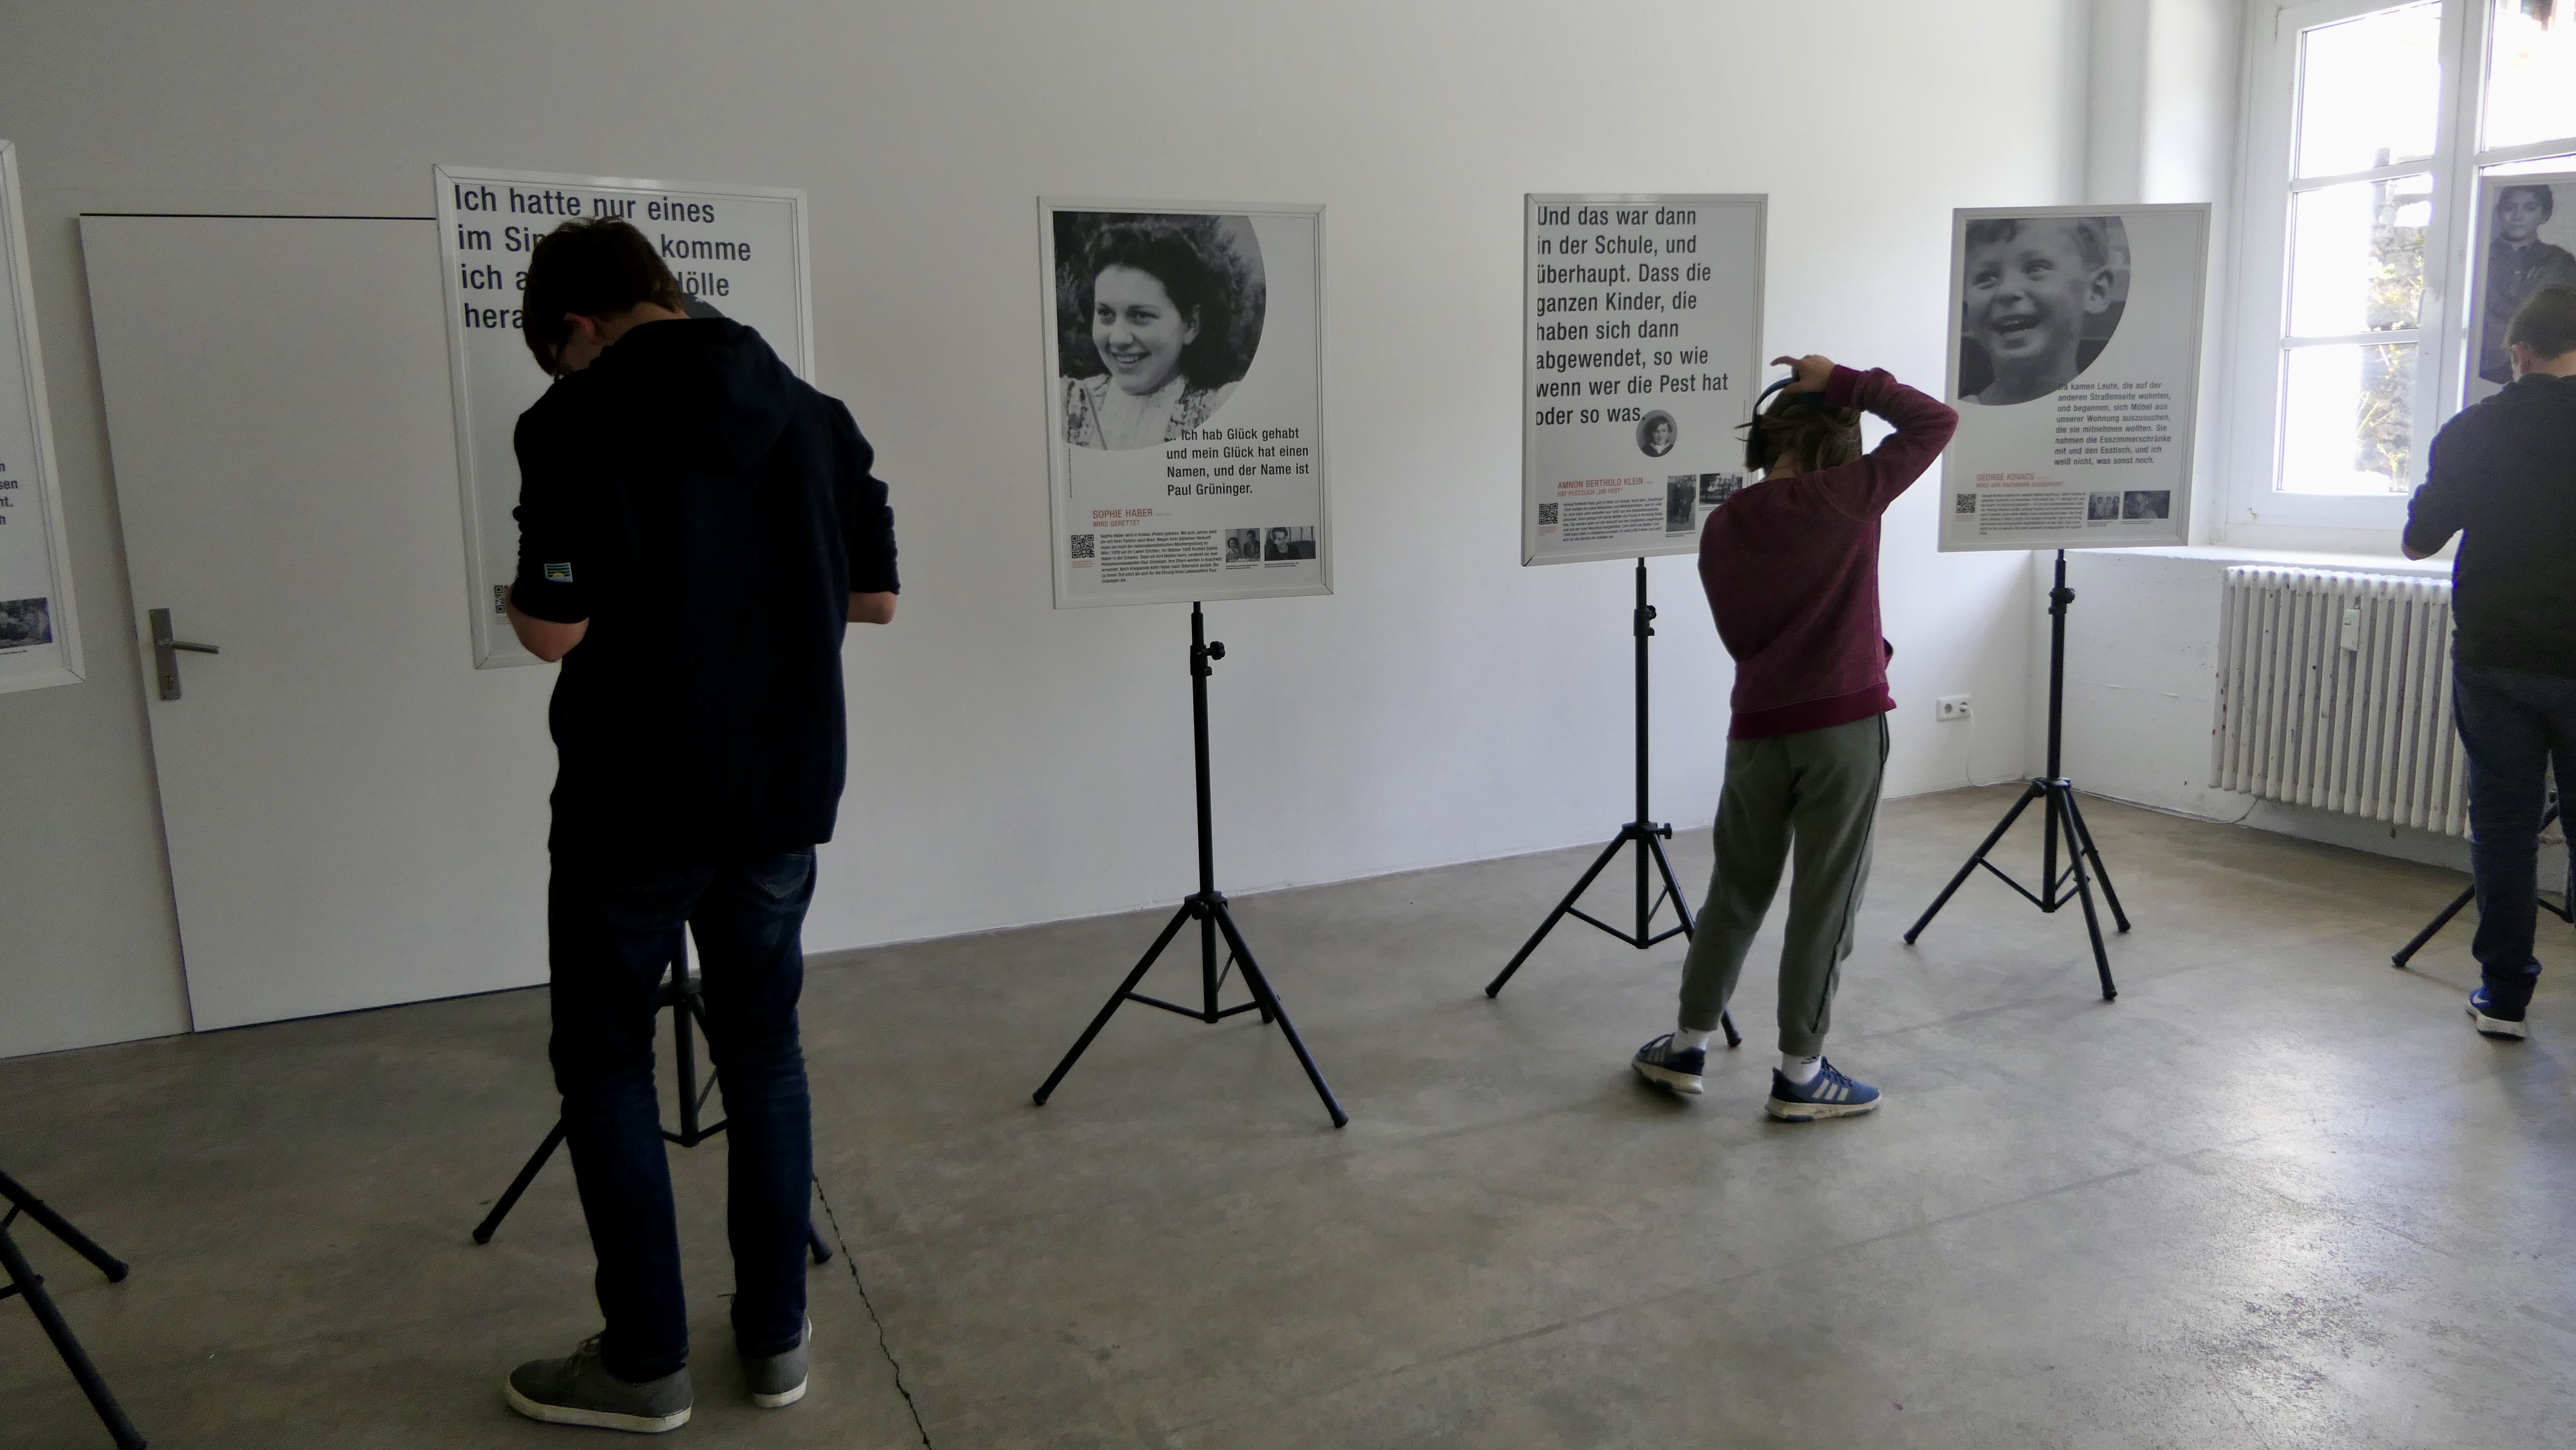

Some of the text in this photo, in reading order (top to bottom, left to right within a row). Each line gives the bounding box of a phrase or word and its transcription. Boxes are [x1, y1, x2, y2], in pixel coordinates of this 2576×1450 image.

[455, 184, 715, 224] Ich hatte nur eines
[1538, 206, 1696, 226] Und das war dann
[458, 224, 492, 251] im
[1538, 235, 1696, 256] in der Schule, und
[660, 234, 751, 261] komme
[461, 263, 502, 290] ich
[1537, 263, 1711, 287] überhaupt. Dass die
[1537, 292, 1696, 317] ganzen Kinder, die
[1537, 320, 1679, 341] haben sich dann
[1537, 346, 1708, 373] abgewendet, so wie
[1537, 373, 1728, 397] wenn wer die Pest hat
[2097, 382, 2119, 390] Leute,
[1536, 407, 1646, 426] oder so was.
[2087, 415, 2119, 423] Wohnung
[1182, 427, 1299, 441] Ich hab Glück gehabt
[2100, 435, 2171, 443] Esszimmerschränke
[1167, 446, 1308, 459] und mein Glück hat einen
[2073, 458, 2093, 466] nicht,
[1167, 463, 1309, 478] Namen, und der Name ist
[1168, 483, 1253, 497] Paul Grüninger.
[1558, 480, 1583, 489] AMNON
[1586, 478, 1621, 488] BERTHOLD
[1624, 477, 1643, 486] KLEIN
[1093, 510, 1122, 519] SOPHIE
[1125, 508, 1153, 517] HABER
